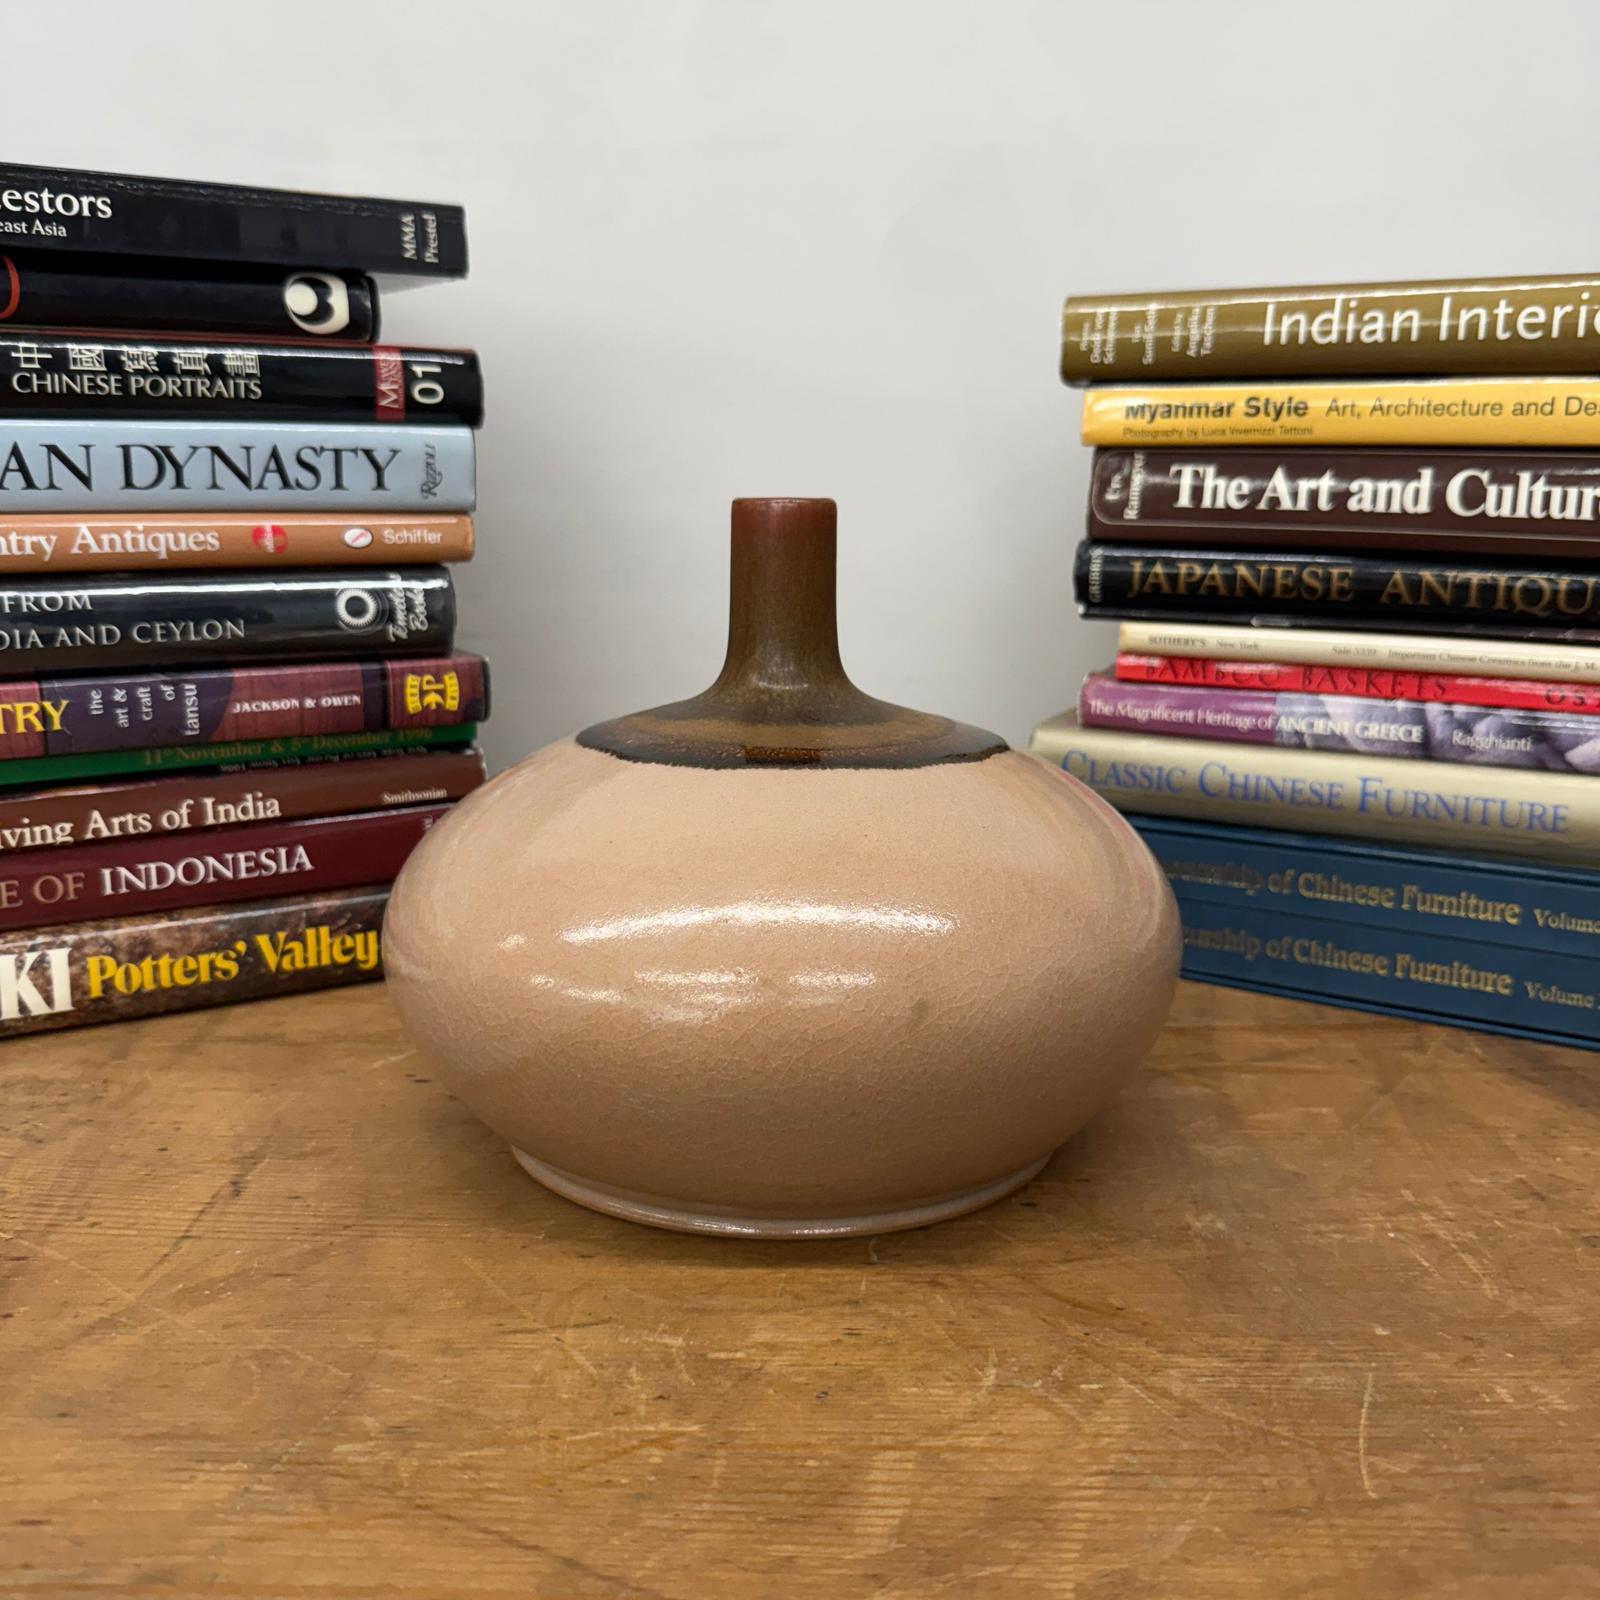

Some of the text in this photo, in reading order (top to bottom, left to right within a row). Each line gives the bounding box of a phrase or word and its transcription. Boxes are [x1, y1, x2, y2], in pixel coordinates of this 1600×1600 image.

[0, 187, 113, 219] estors
[31, 218, 68, 237] Asia
[401, 213, 418, 260] MMA
[421, 211, 440, 263] Prestel
[1262, 291, 1600, 346] Indian Interi
[12, 372, 262, 400] CHINESE PORTRAITS
[412, 363, 444, 405] 01
[1125, 401, 1236, 423] Myanmar
[1243, 396, 1308, 420] Style
[1325, 396, 1360, 418] Art,
[1370, 395, 1502, 417] Architecture
[1512, 396, 1554, 416] and
[1122, 427, 1183, 439] Photography
[1186, 428, 1198, 438] by
[117, 443, 402, 492] DYNASTY
[1169, 463, 1600, 521] The Art and Cultur
[71, 524, 220, 560] Antiques
[383, 529, 442, 545] Schiffer
[1127, 560, 1356, 602] JAPANESE
[2, 593, 93, 613] FROM
[55, 624, 121, 648] AND
[132, 619, 246, 644] CEYLON
[87, 688, 104, 715] the
[137, 685, 153, 721] craft
[160, 684, 176, 701] of
[232, 693, 361, 713] JACKSON & OWEN
[1302, 668, 1447, 697] BASKETS
[1545, 688, 1600, 707] OS
[0, 699, 70, 735] TRY
[113, 687, 130, 728] art &
[182, 683, 200, 736] tansu
[1088, 700, 1424, 743] The Magnificent Heritage of ANCIENT GREECE
[1452, 730, 1534, 752] Ragghianti
[383, 789, 447, 804] Smithsonian
[1061, 750, 1570, 834] CLASSIC CHINESE FURNITURE
[84, 802, 152, 840] Arts
[161, 800, 195, 829] of
[203, 792, 282, 822] India
[33, 872, 86, 904] OF
[100, 845, 315, 897] INDONESIA
[1267, 868, 1296, 896] of
[1298, 872, 1396, 909] Chinese
[1400, 884, 1522, 926] Furniture
[254, 925, 379, 974] Valley
[1265, 935, 1292, 961] of
[1292, 939, 1389, 978] Chinese
[1393, 953, 1514, 996] Furniture
[1523, 979, 1595, 1009] Volume
